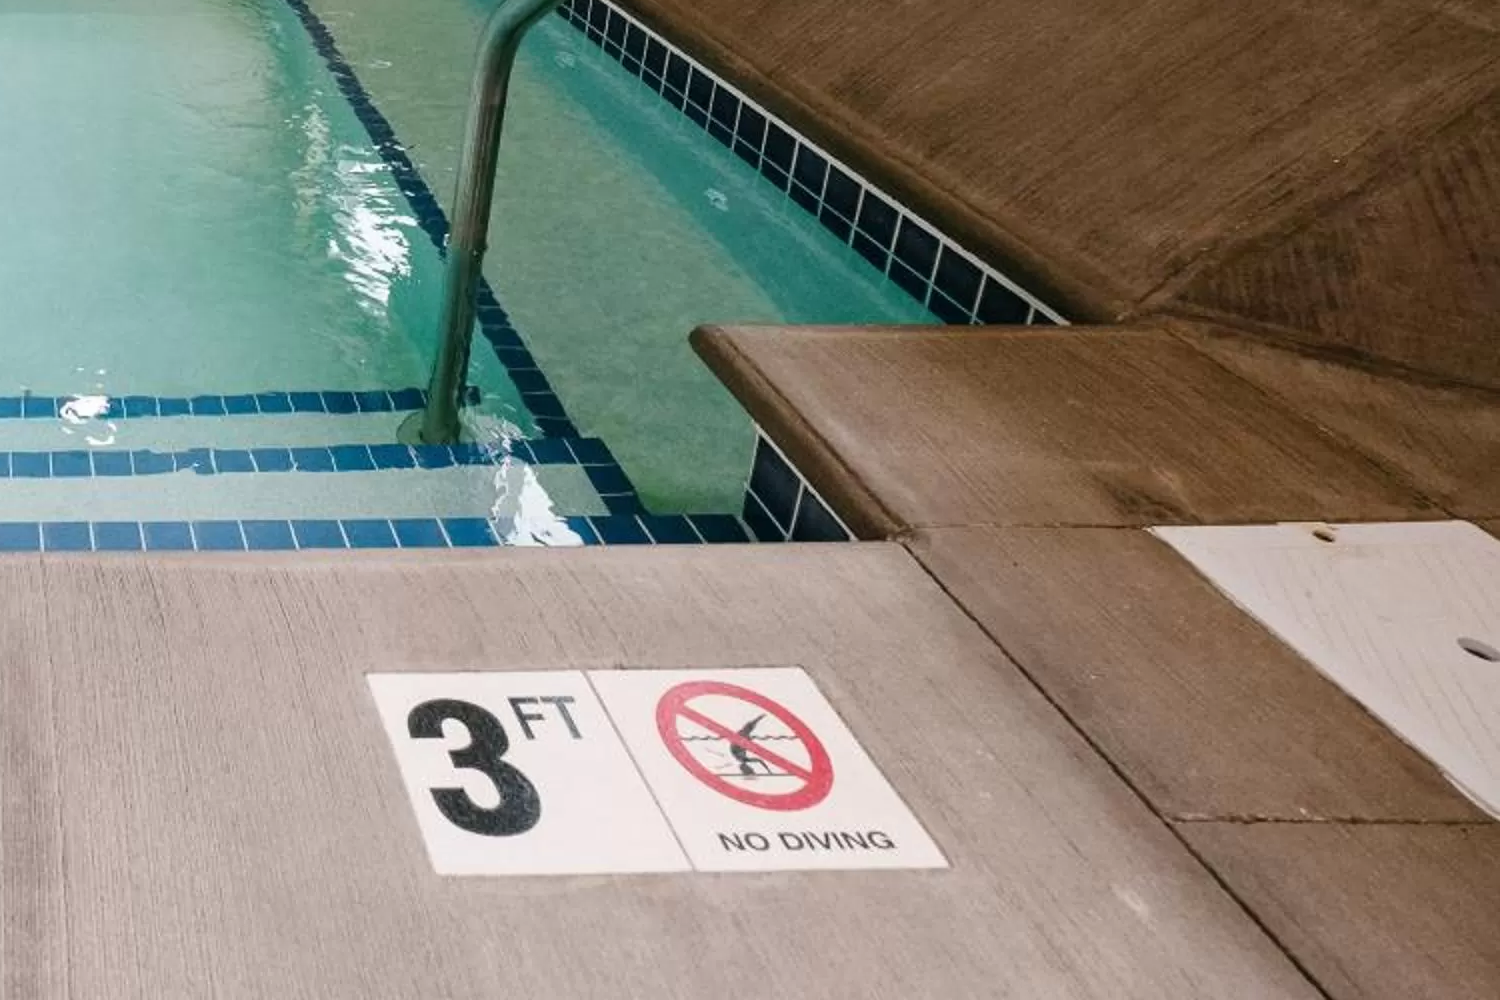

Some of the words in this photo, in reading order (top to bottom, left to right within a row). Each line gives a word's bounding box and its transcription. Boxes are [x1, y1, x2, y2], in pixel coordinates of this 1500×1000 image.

[406, 697, 543, 838] 3
[506, 695, 584, 741] FT
[717, 831, 771, 851] NO
[777, 830, 897, 851] DIVING
